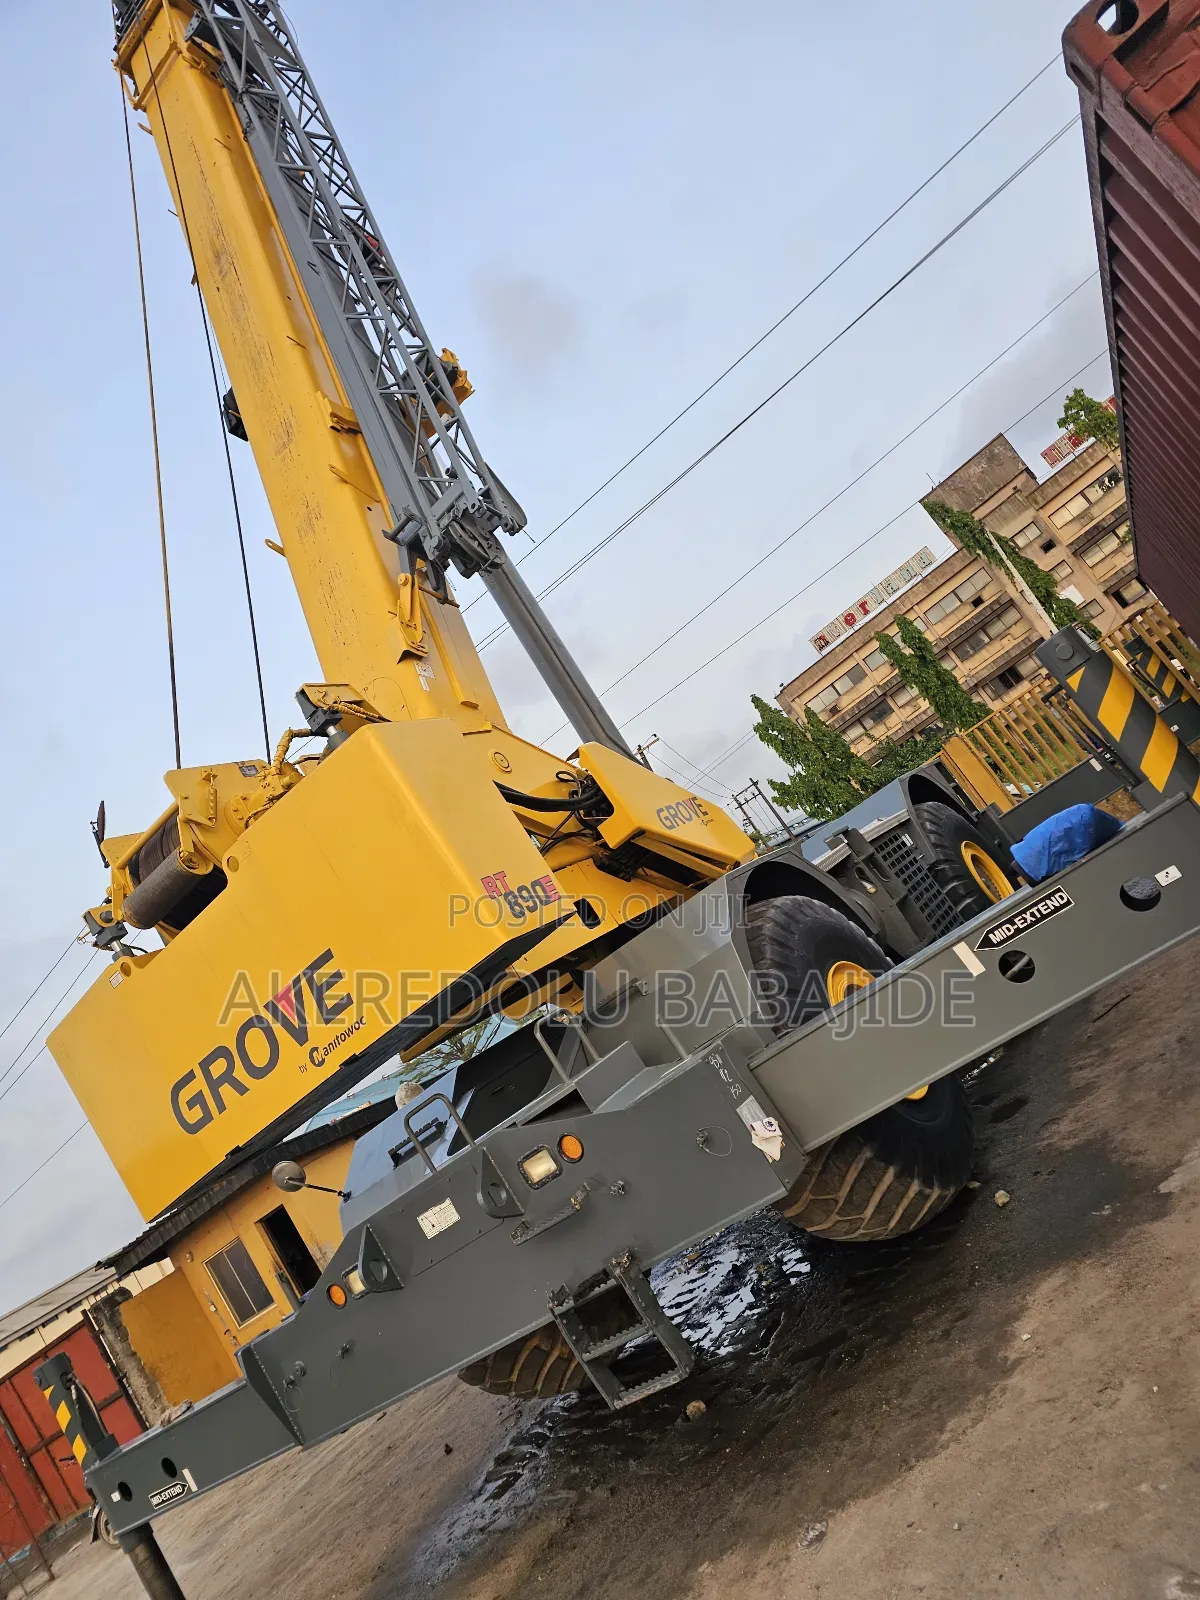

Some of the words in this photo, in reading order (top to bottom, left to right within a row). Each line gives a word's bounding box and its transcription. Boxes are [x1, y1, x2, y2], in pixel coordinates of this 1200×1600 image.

[656, 796, 709, 830] GROVE
[480, 870, 508, 900] RT
[503, 874, 562, 919] 890E
[988, 891, 1068, 944] MID-EXTEND
[170, 947, 354, 1135] GROVE
[309, 1016, 367, 1068] Manitowoc
[151, 1484, 184, 1506] MID-EXTEND
